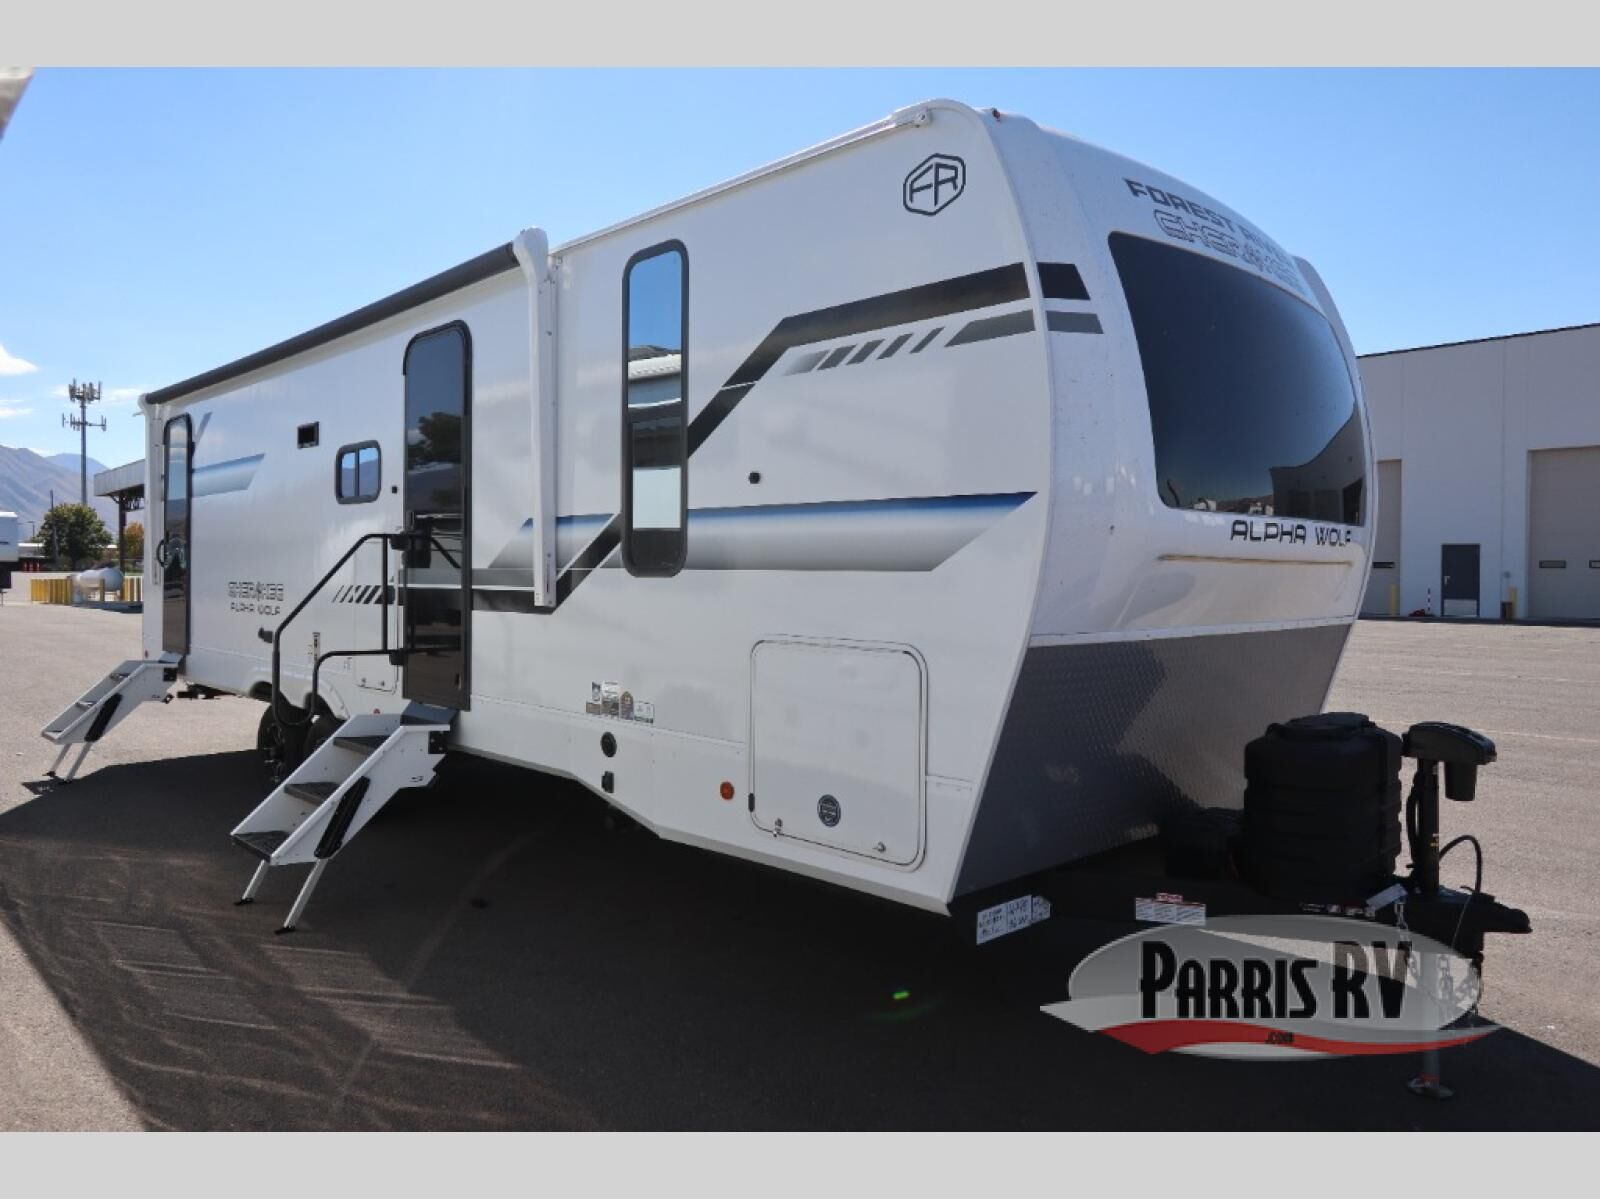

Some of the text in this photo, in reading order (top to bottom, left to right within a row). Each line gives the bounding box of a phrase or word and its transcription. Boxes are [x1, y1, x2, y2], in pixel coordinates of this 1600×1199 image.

[1122, 177, 1237, 233] FOREST
[1230, 519, 1352, 547] ALPHA WOLF
